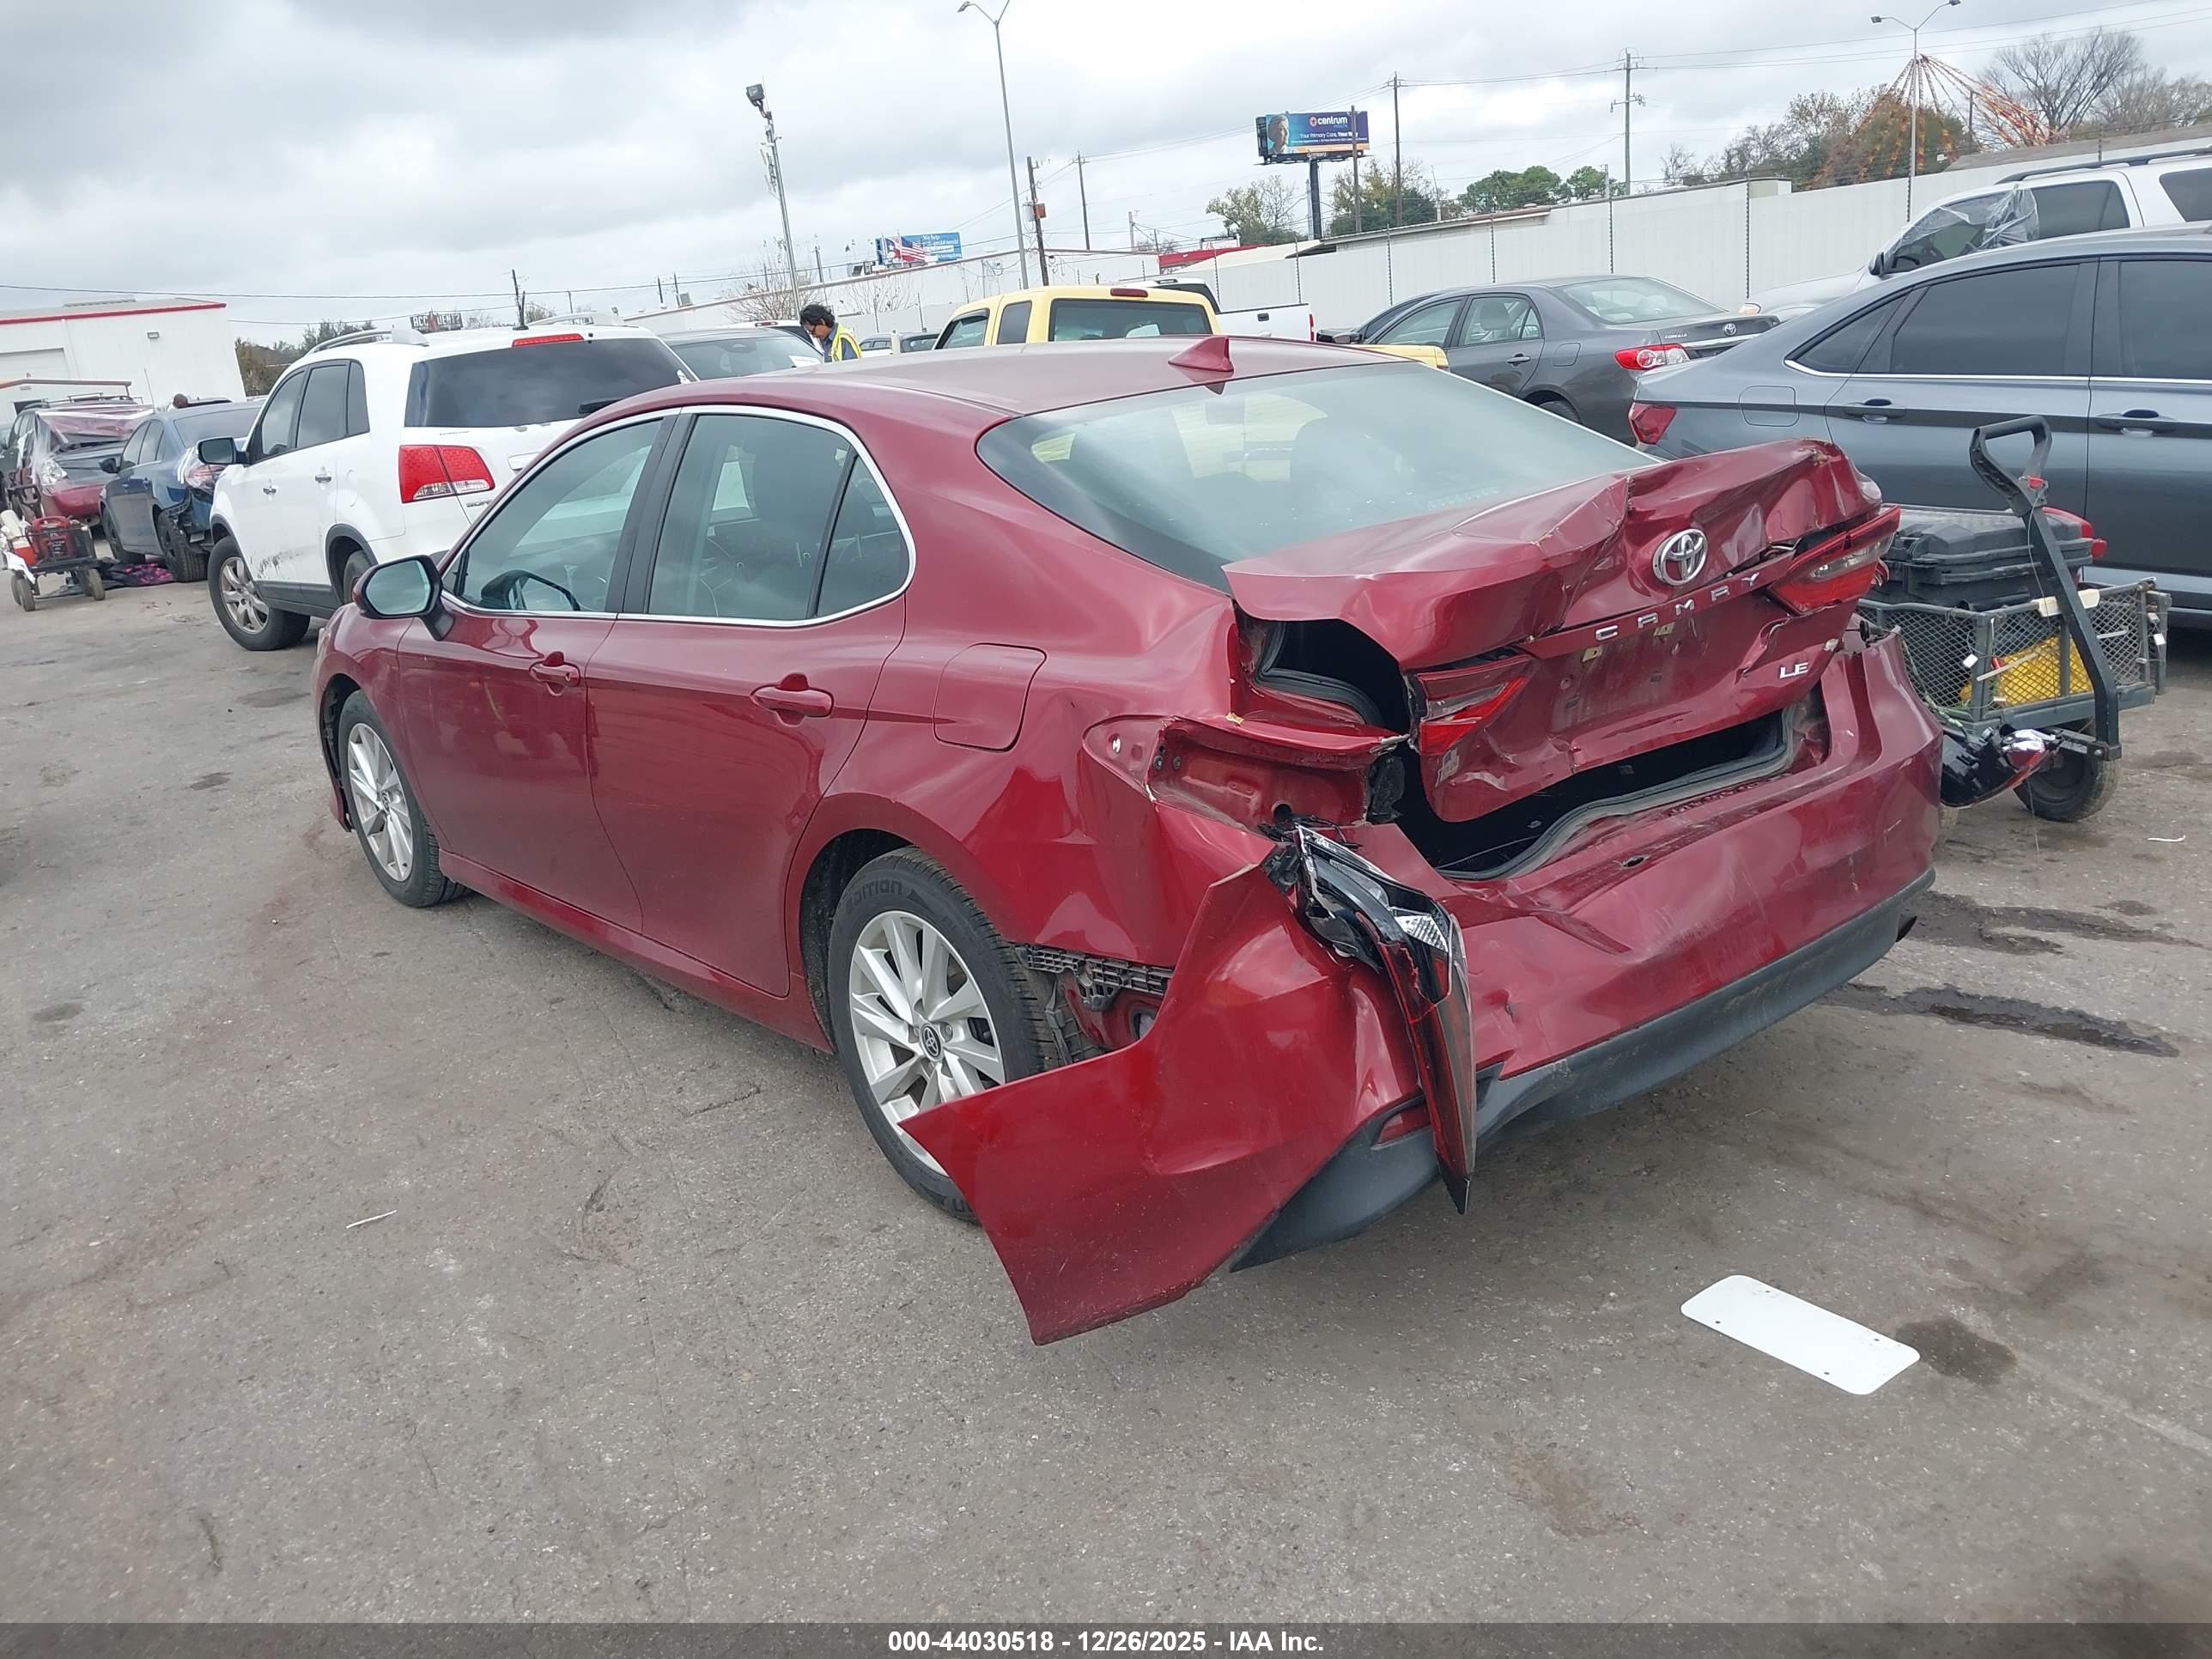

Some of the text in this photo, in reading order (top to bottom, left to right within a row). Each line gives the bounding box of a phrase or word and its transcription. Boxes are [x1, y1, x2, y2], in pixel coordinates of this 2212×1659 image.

[1317, 116, 1348, 125] centrum
[1595, 572, 1760, 641] CAMRY
[1779, 662, 1808, 678] LE
